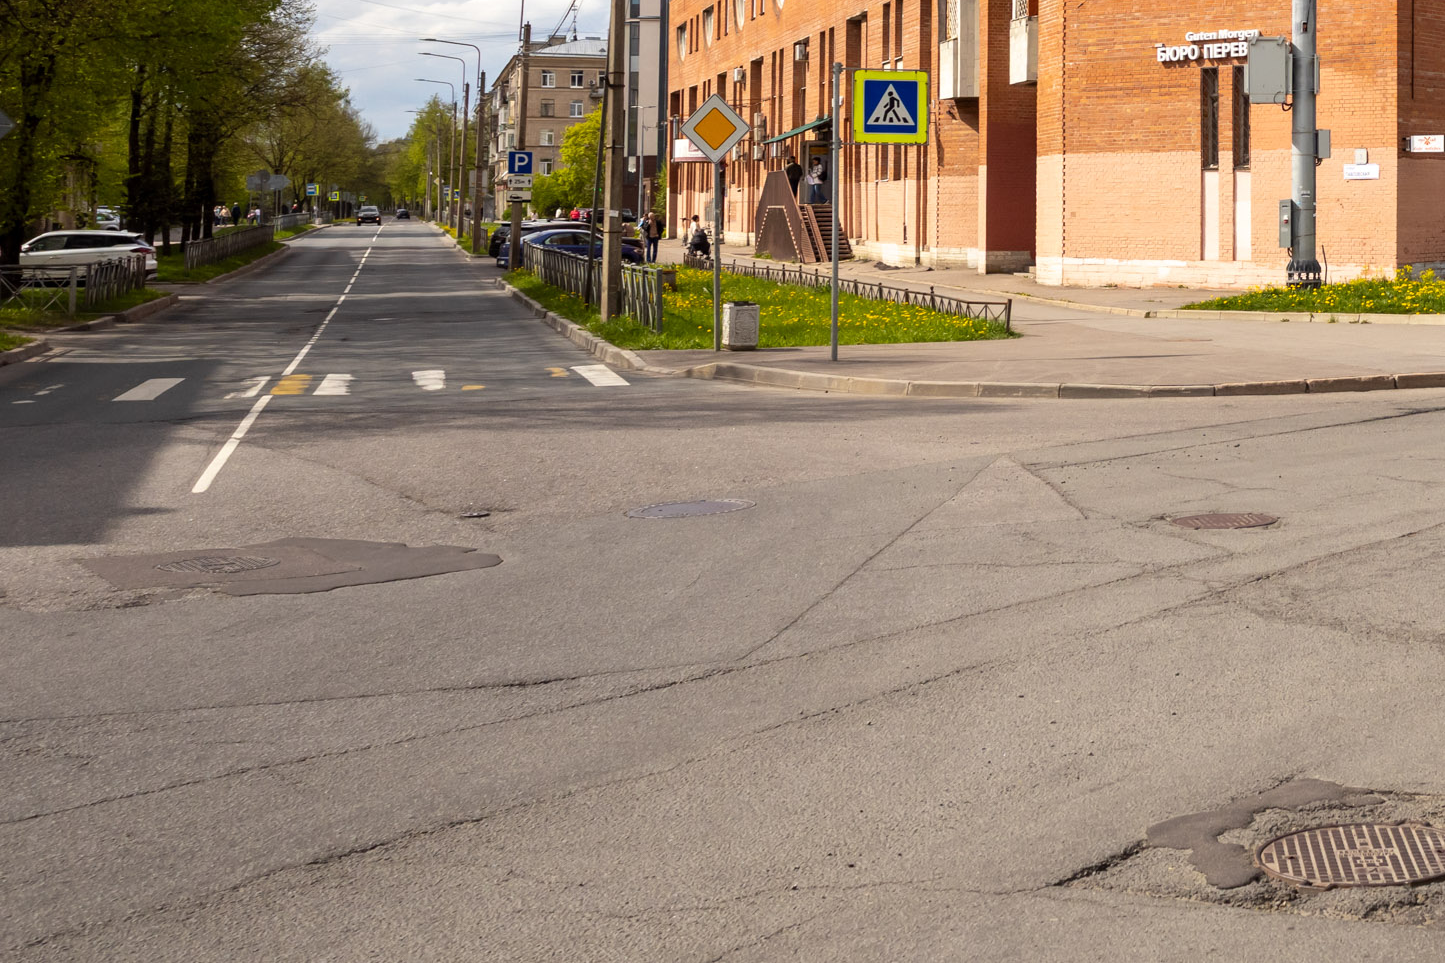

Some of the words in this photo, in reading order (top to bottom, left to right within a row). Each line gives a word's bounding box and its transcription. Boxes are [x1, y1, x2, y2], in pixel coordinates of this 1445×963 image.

[1185, 31, 1216, 41] Guten
[1218, 29, 1259, 40] Morgen
[1157, 44, 1199, 62] БЮРО
[1203, 41, 1248, 59] ПЕРЕВ
